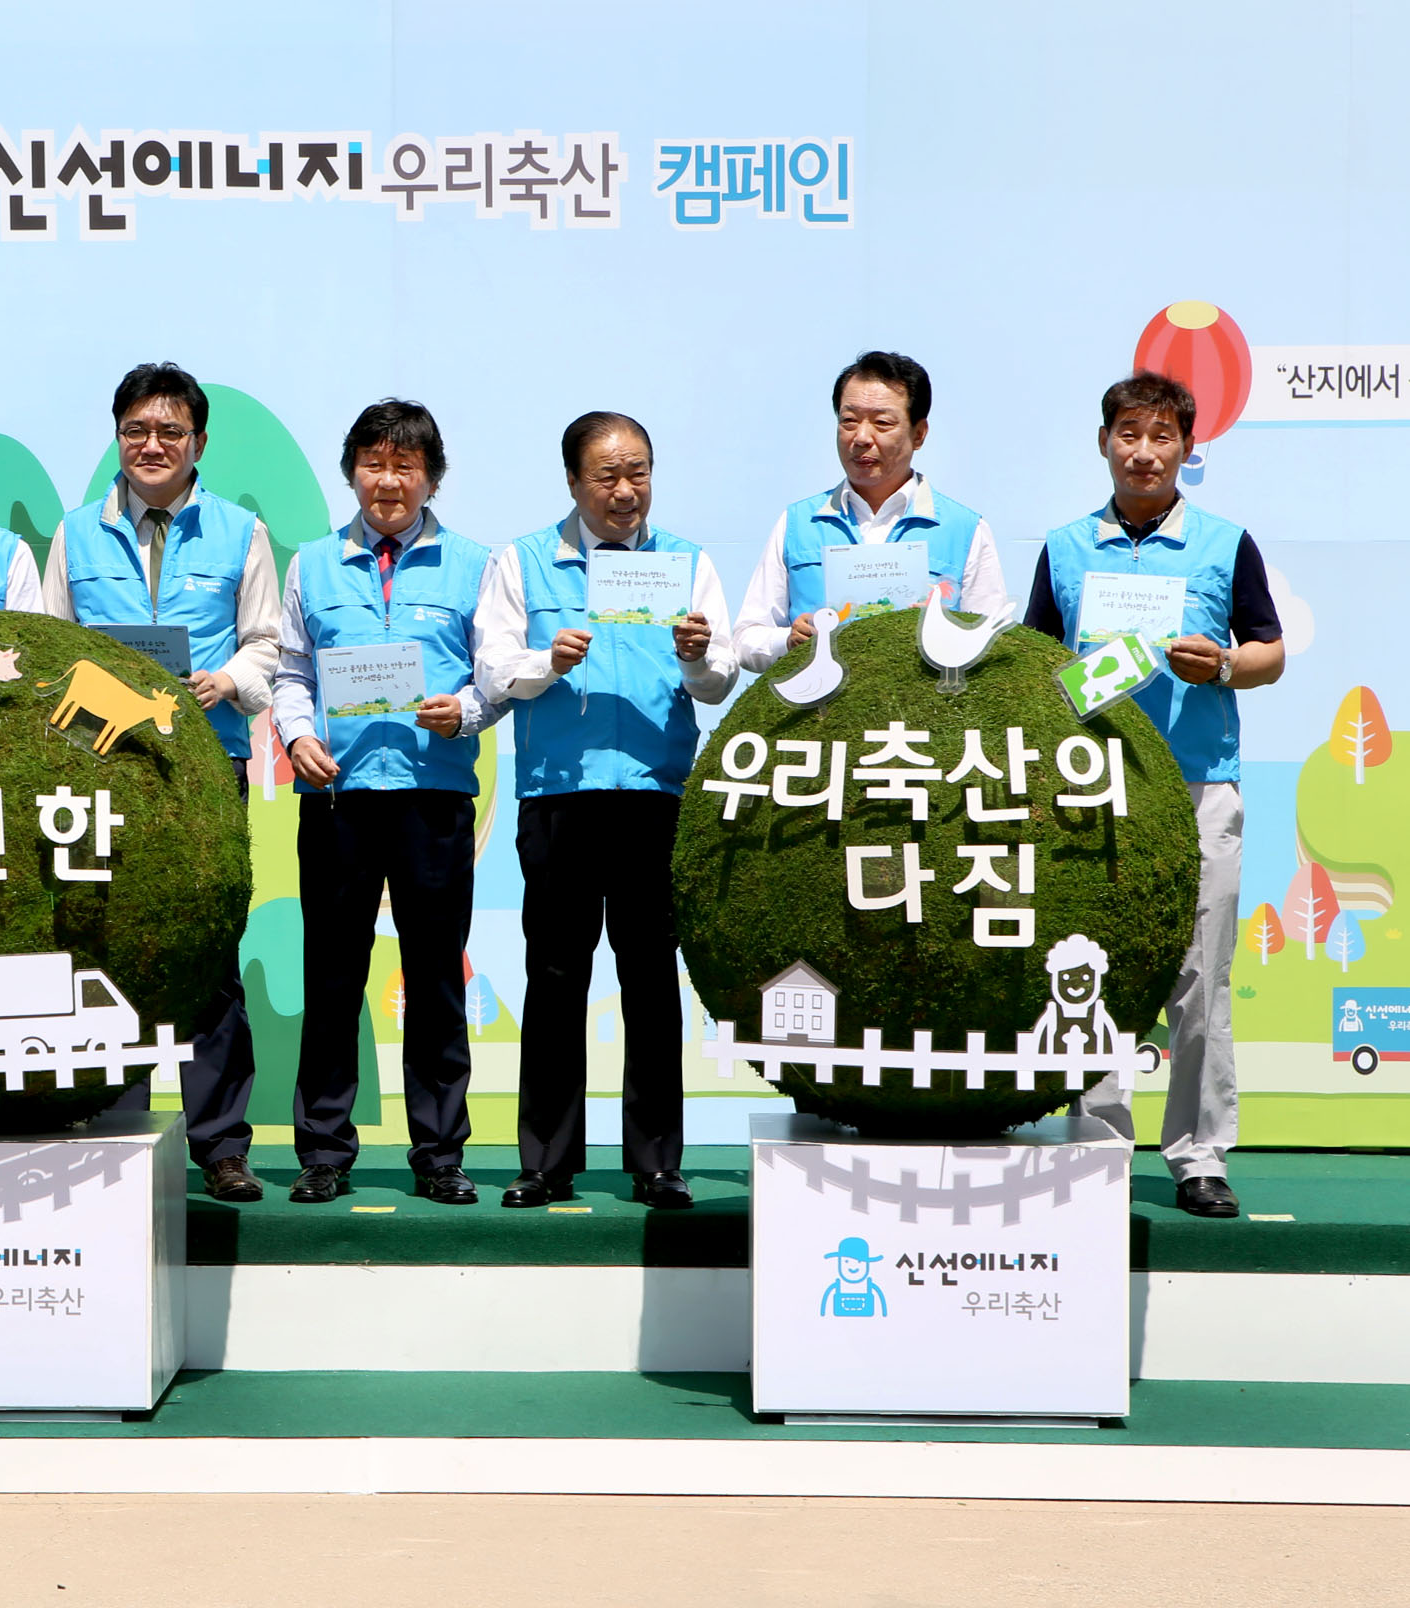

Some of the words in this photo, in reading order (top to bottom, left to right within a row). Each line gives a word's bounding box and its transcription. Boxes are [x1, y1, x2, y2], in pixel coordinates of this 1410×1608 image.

[380, 139, 620, 221] 우리축산
[657, 142, 850, 226] 캠페인
[701, 720, 1129, 823] 우리축산의
[845, 842, 1036, 949] 다짐
[895, 1252, 1059, 1286] 신선에너지
[960, 1291, 1063, 1321] 우리축산
